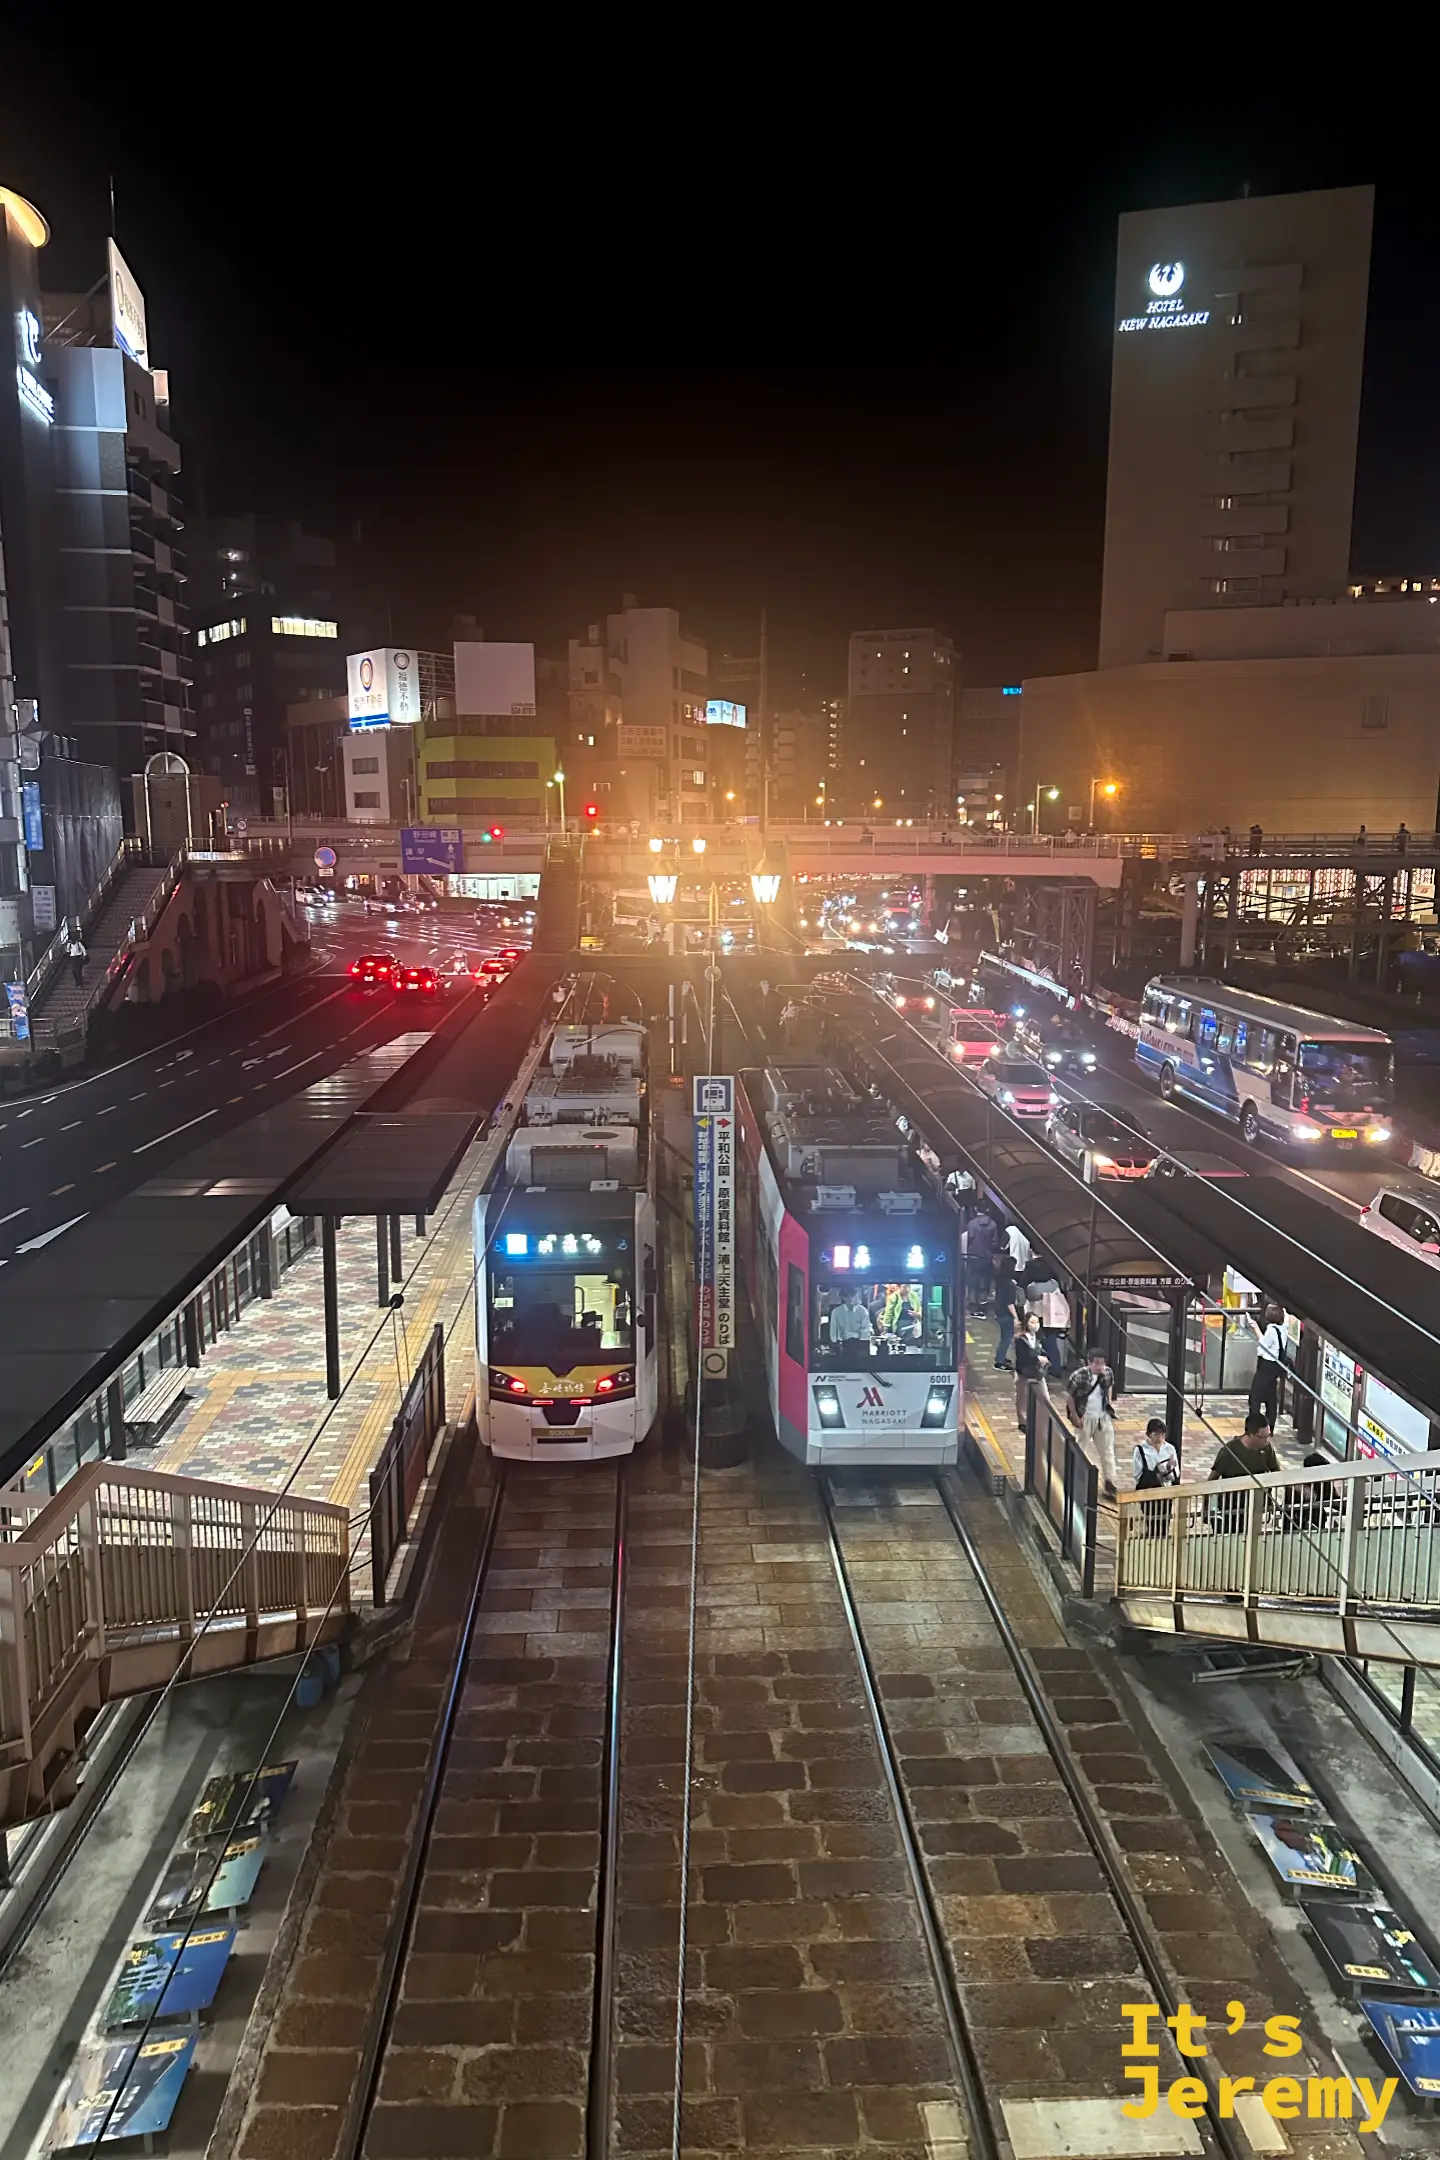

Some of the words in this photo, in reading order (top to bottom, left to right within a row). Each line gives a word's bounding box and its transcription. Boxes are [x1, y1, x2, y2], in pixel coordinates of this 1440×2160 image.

[1146, 299, 1184, 313] HOTEL
[1118, 317, 1148, 332] NEW
[1148, 311, 1210, 329] NAGASAKI
[718, 1312, 731, 1345] のりば
[930, 1375, 951, 1384] 6001
